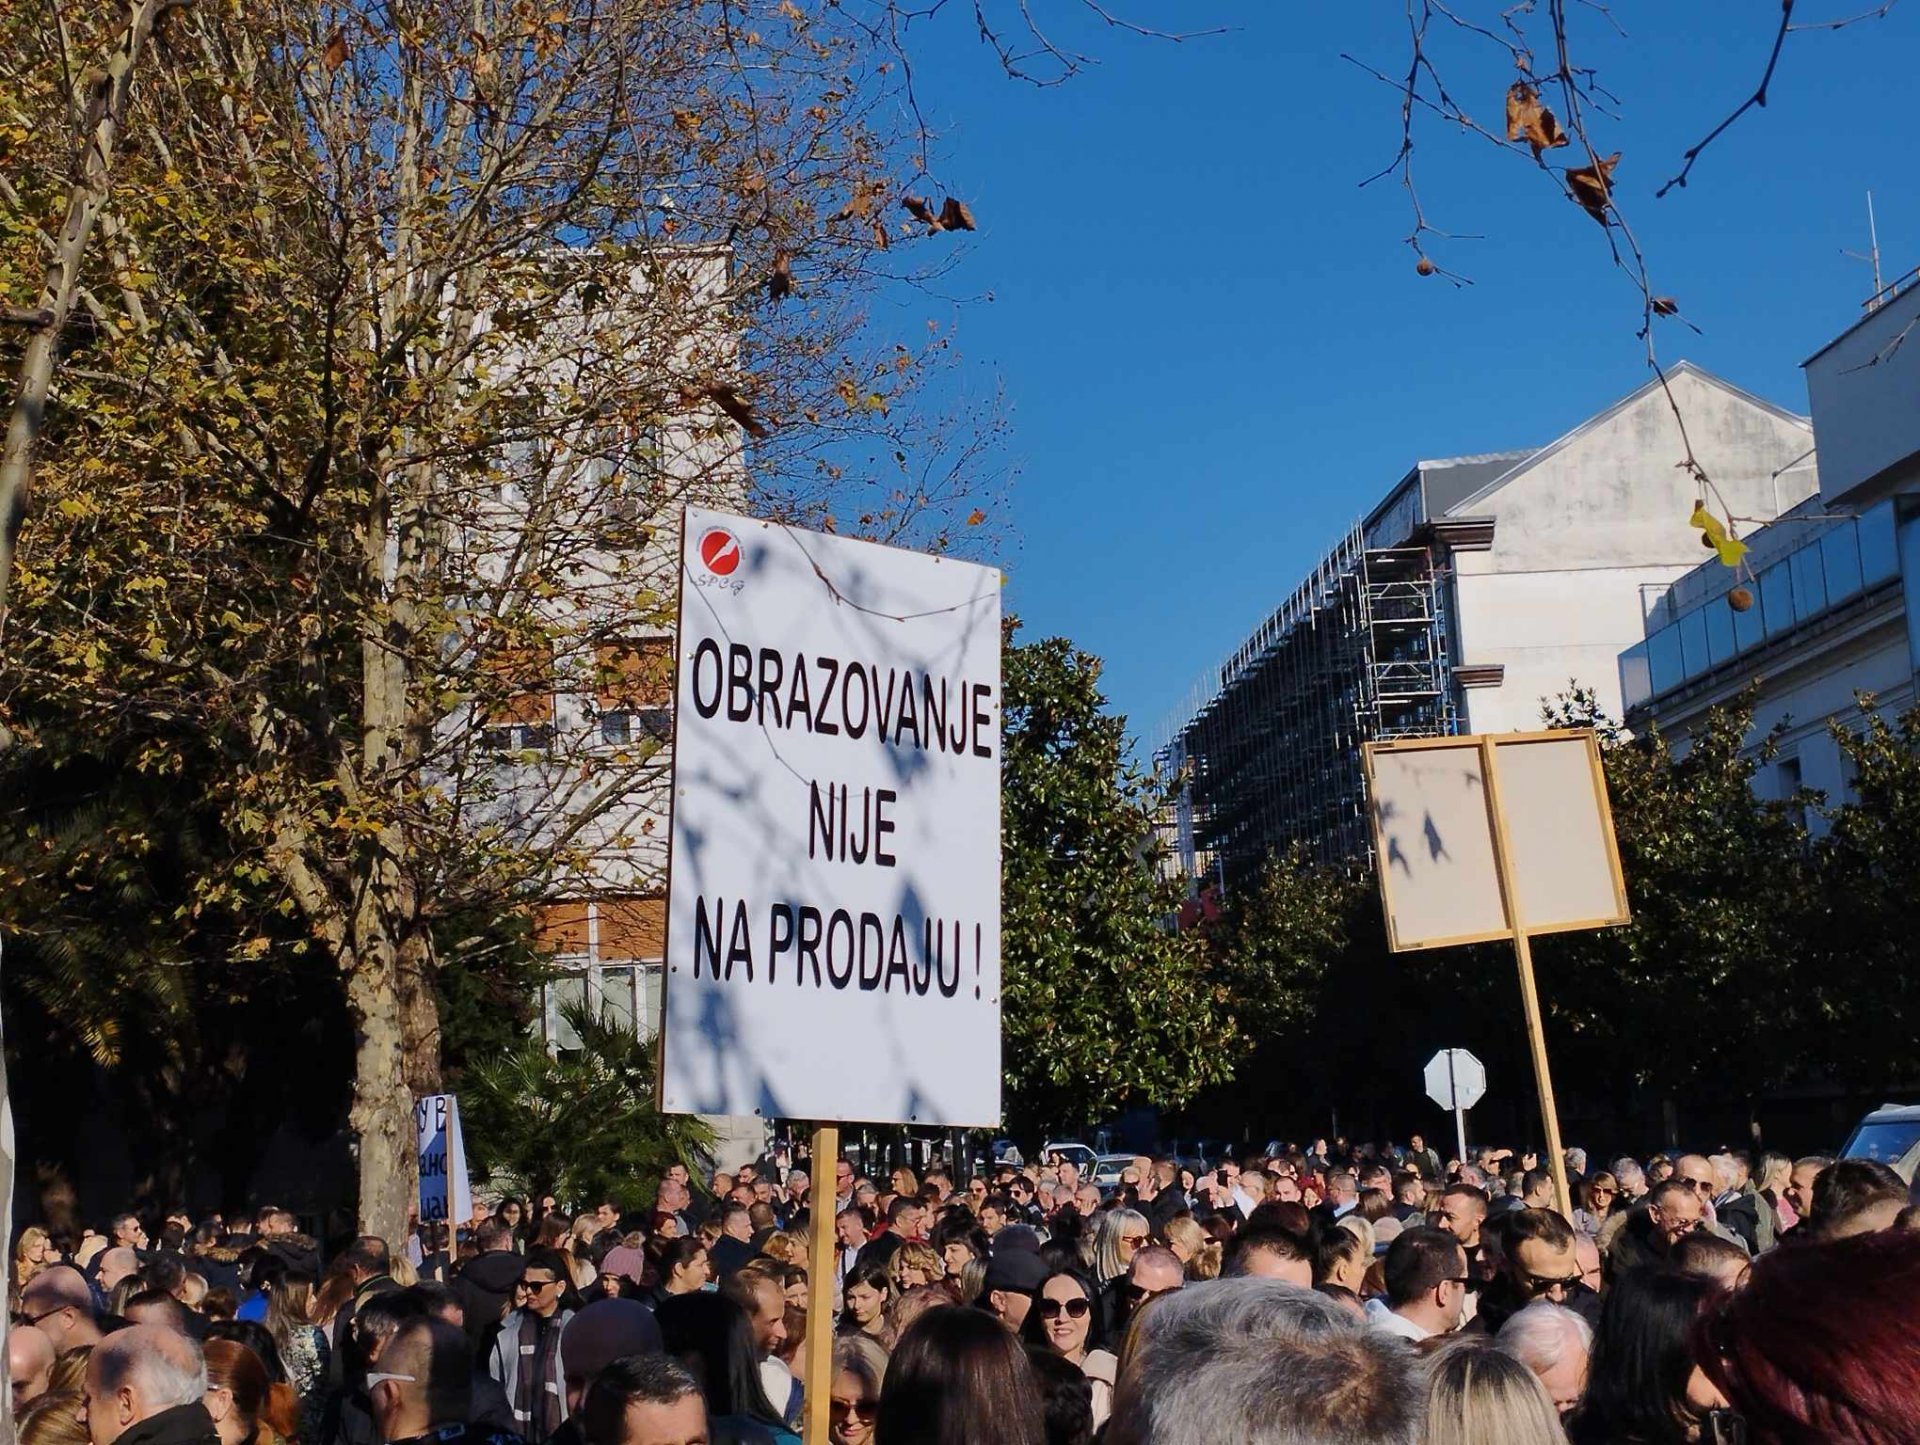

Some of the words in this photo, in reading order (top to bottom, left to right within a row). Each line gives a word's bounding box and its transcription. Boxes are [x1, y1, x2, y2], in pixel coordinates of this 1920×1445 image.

[692, 637, 992, 758] OBRAZOVANJE
[809, 779, 896, 867] NIJE
[694, 895, 753, 982] NA
